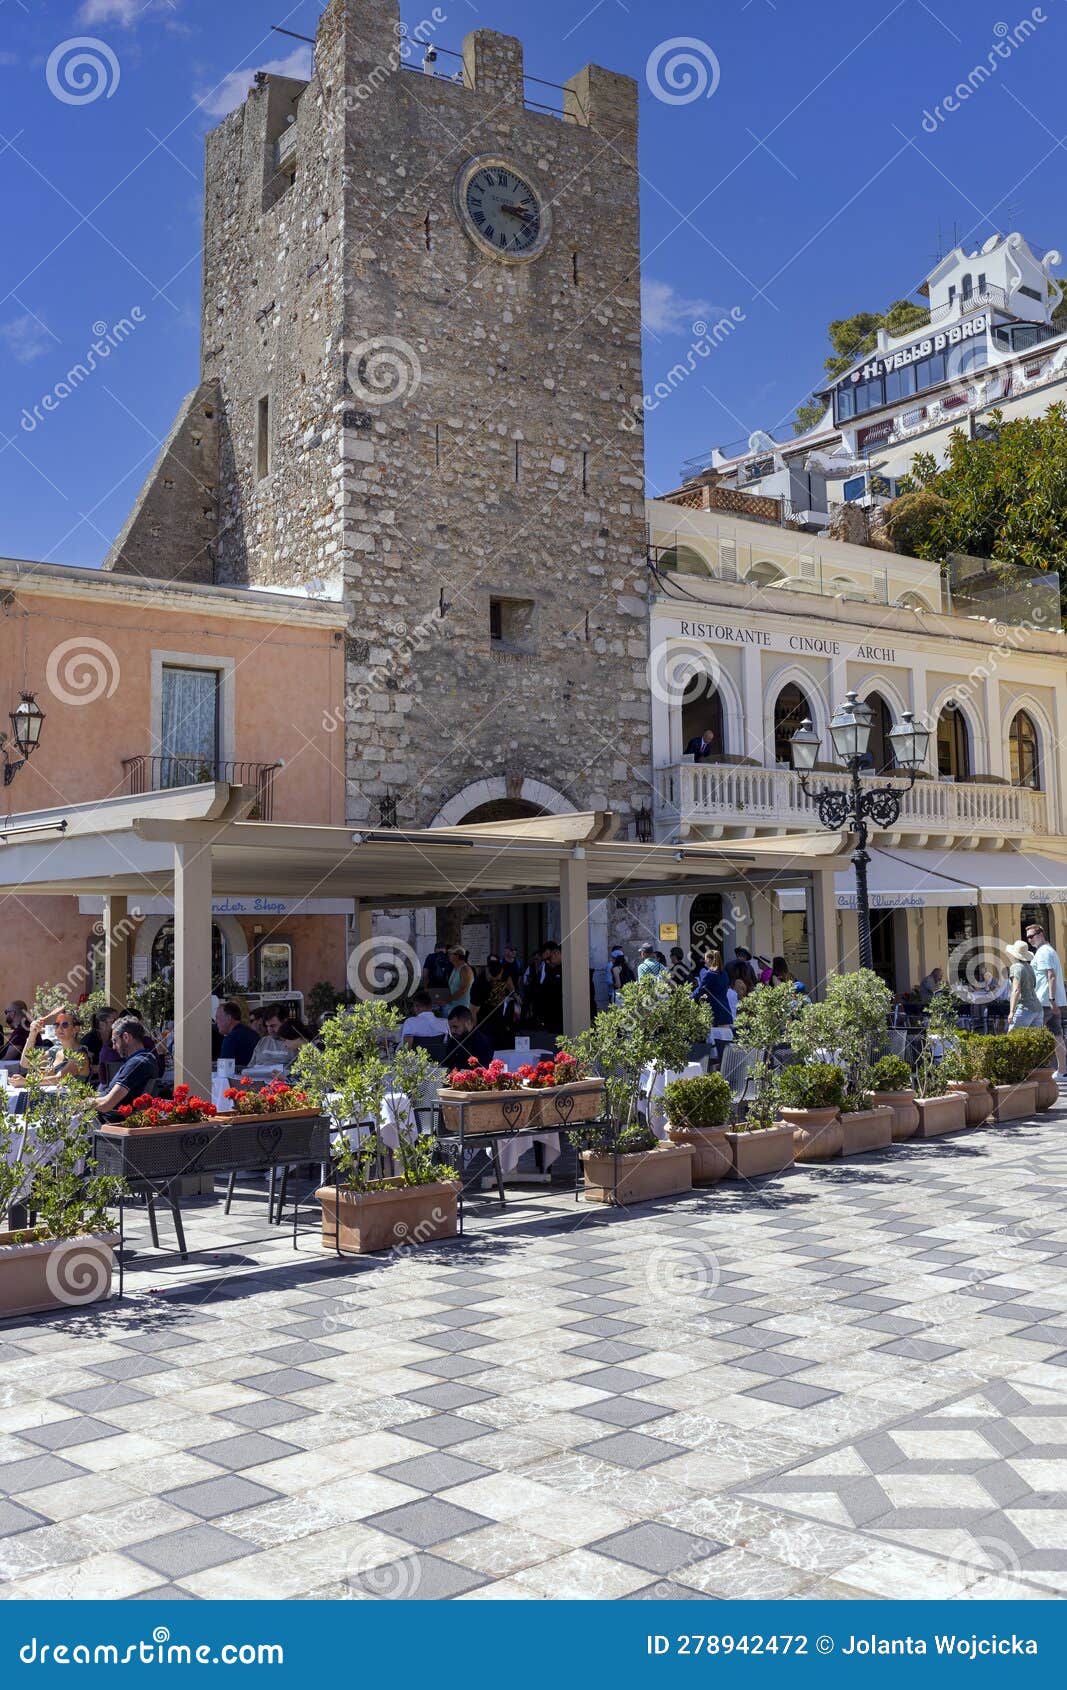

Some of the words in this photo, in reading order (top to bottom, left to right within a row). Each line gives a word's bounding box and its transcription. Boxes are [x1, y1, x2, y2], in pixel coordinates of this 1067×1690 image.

[884, 340, 933, 375] VELLO
[934, 316, 986, 352] D'ORO
[680, 620, 772, 646] RISTORANTE
[789, 635, 841, 655] CINQUE
[857, 644, 896, 662] ARCHI
[254, 898, 286, 913] Shop
[871, 893, 925, 907] Wunderbar
